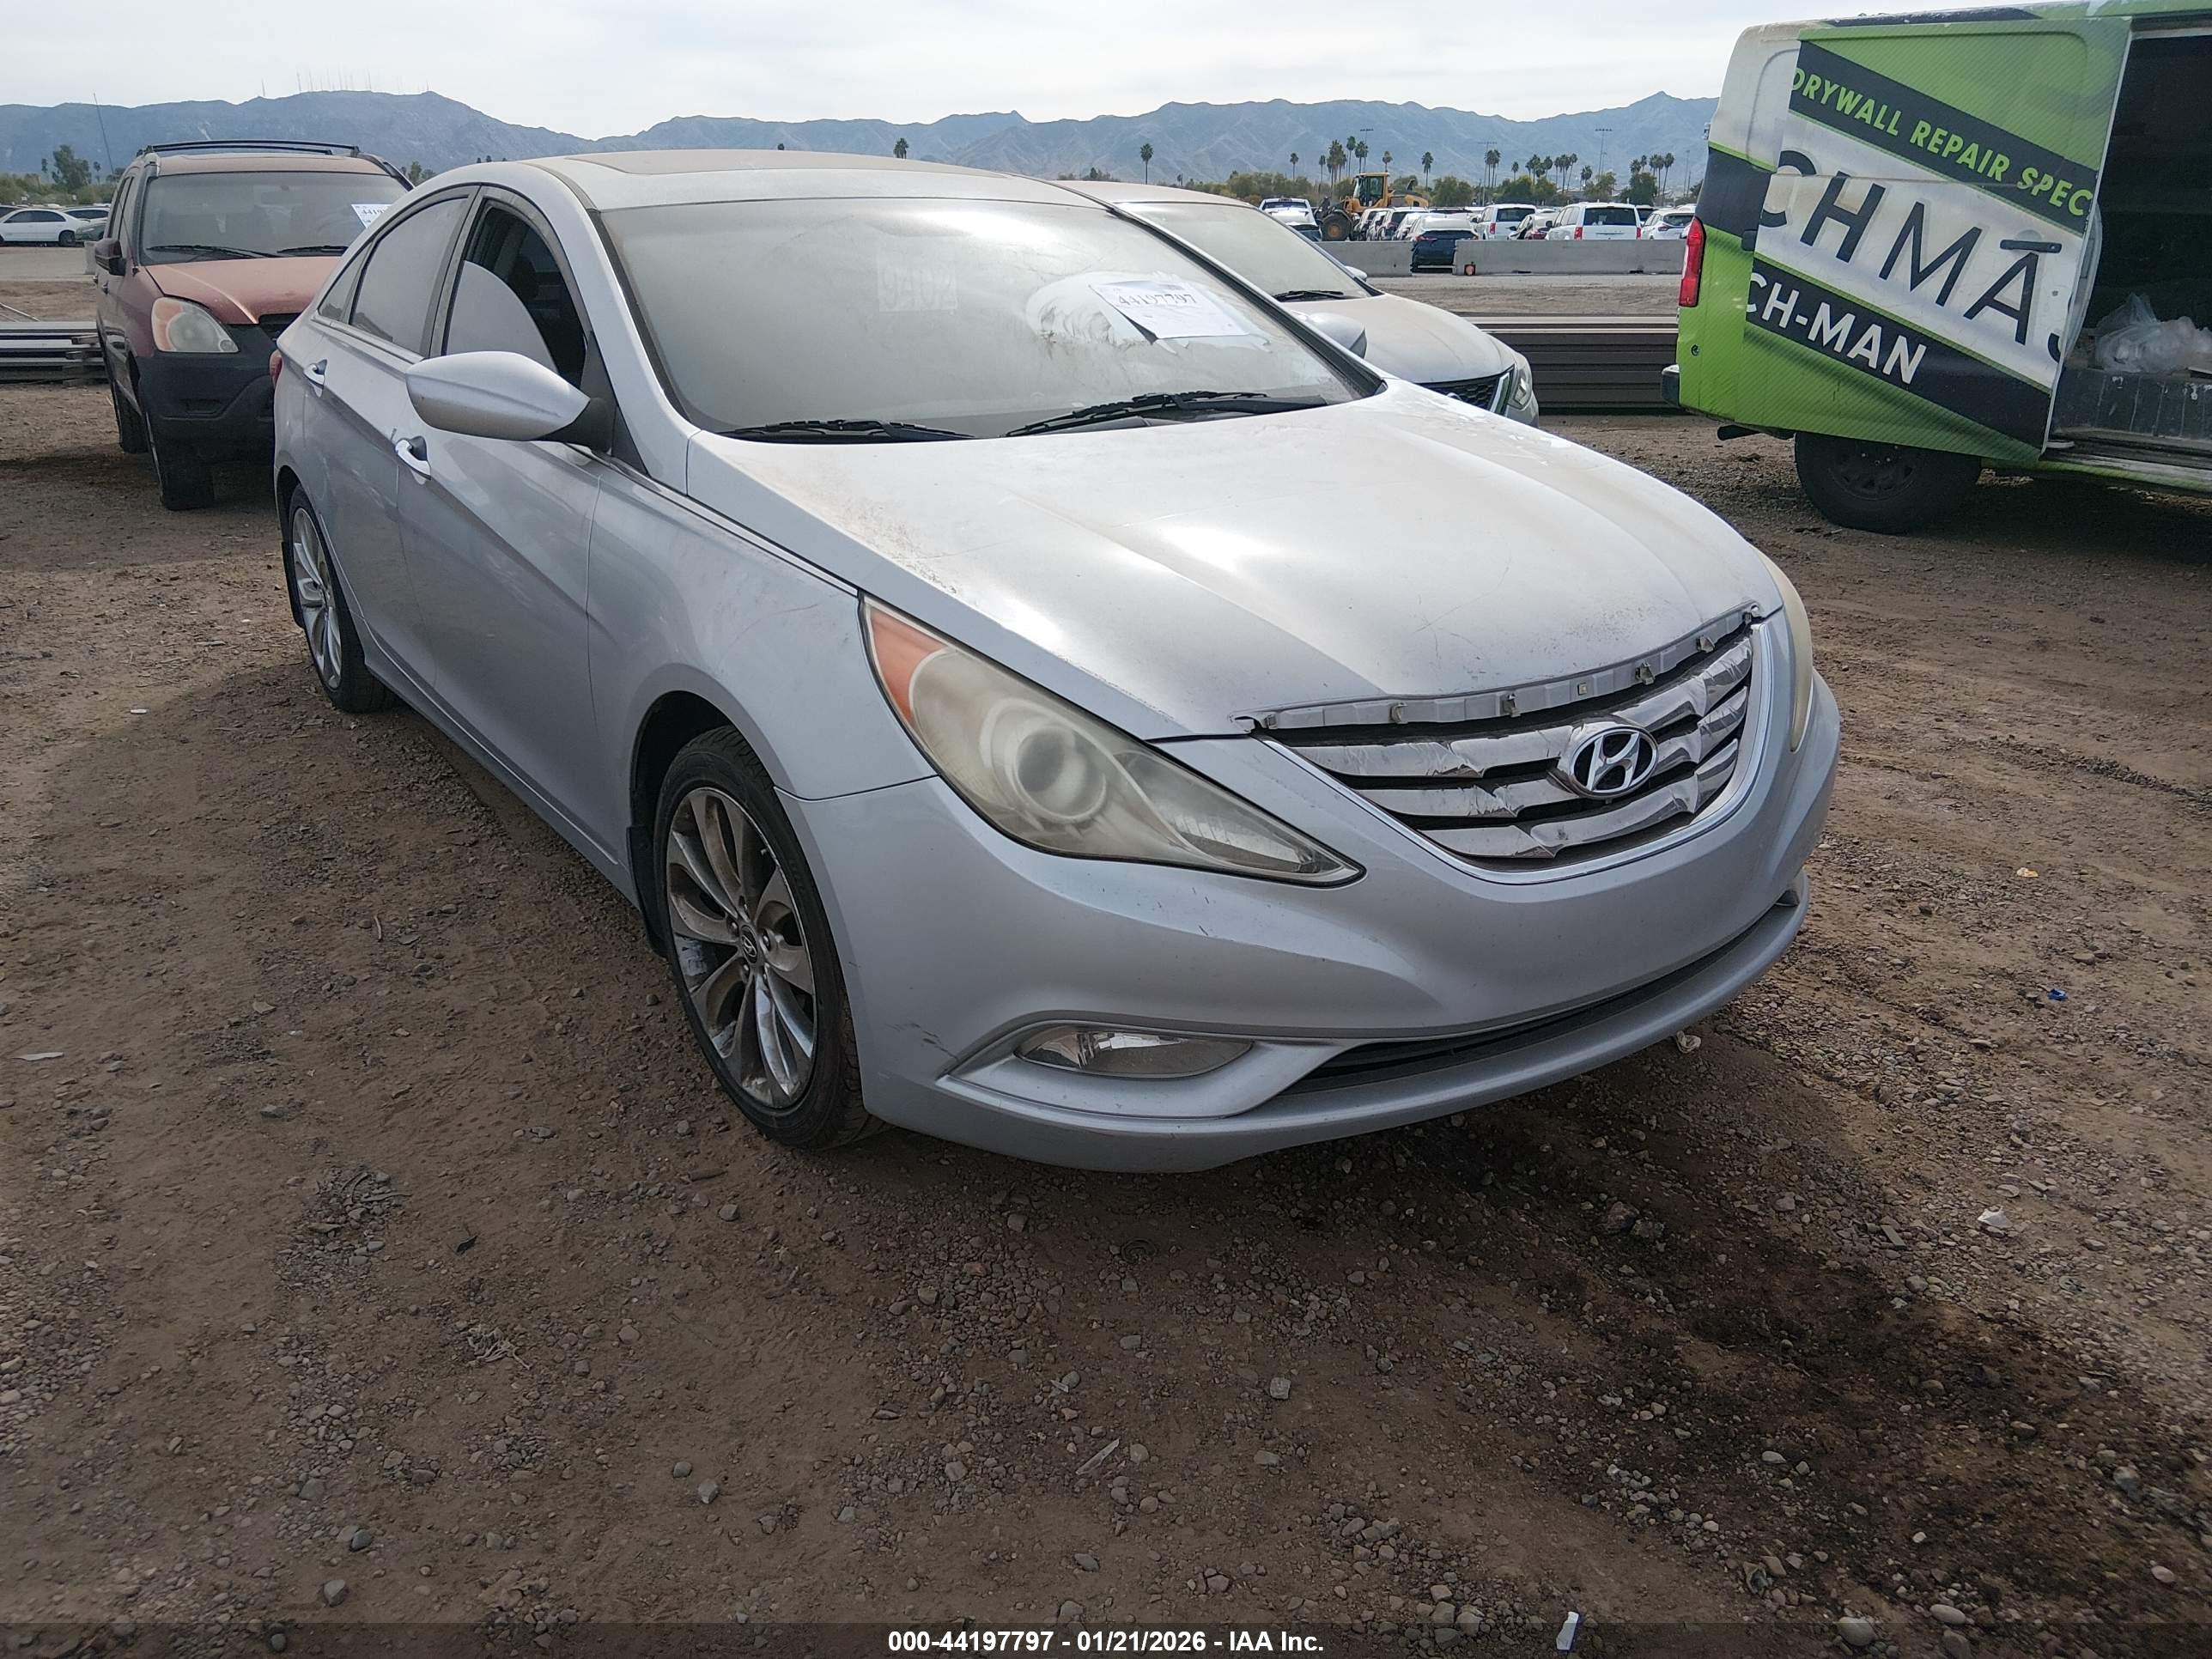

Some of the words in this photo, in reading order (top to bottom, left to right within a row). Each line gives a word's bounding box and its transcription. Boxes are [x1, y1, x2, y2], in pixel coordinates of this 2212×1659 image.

[1792, 67, 1902, 136] DRYWALL
[1910, 119, 2010, 182] REPAIR
[2017, 167, 2094, 216] SPEC
